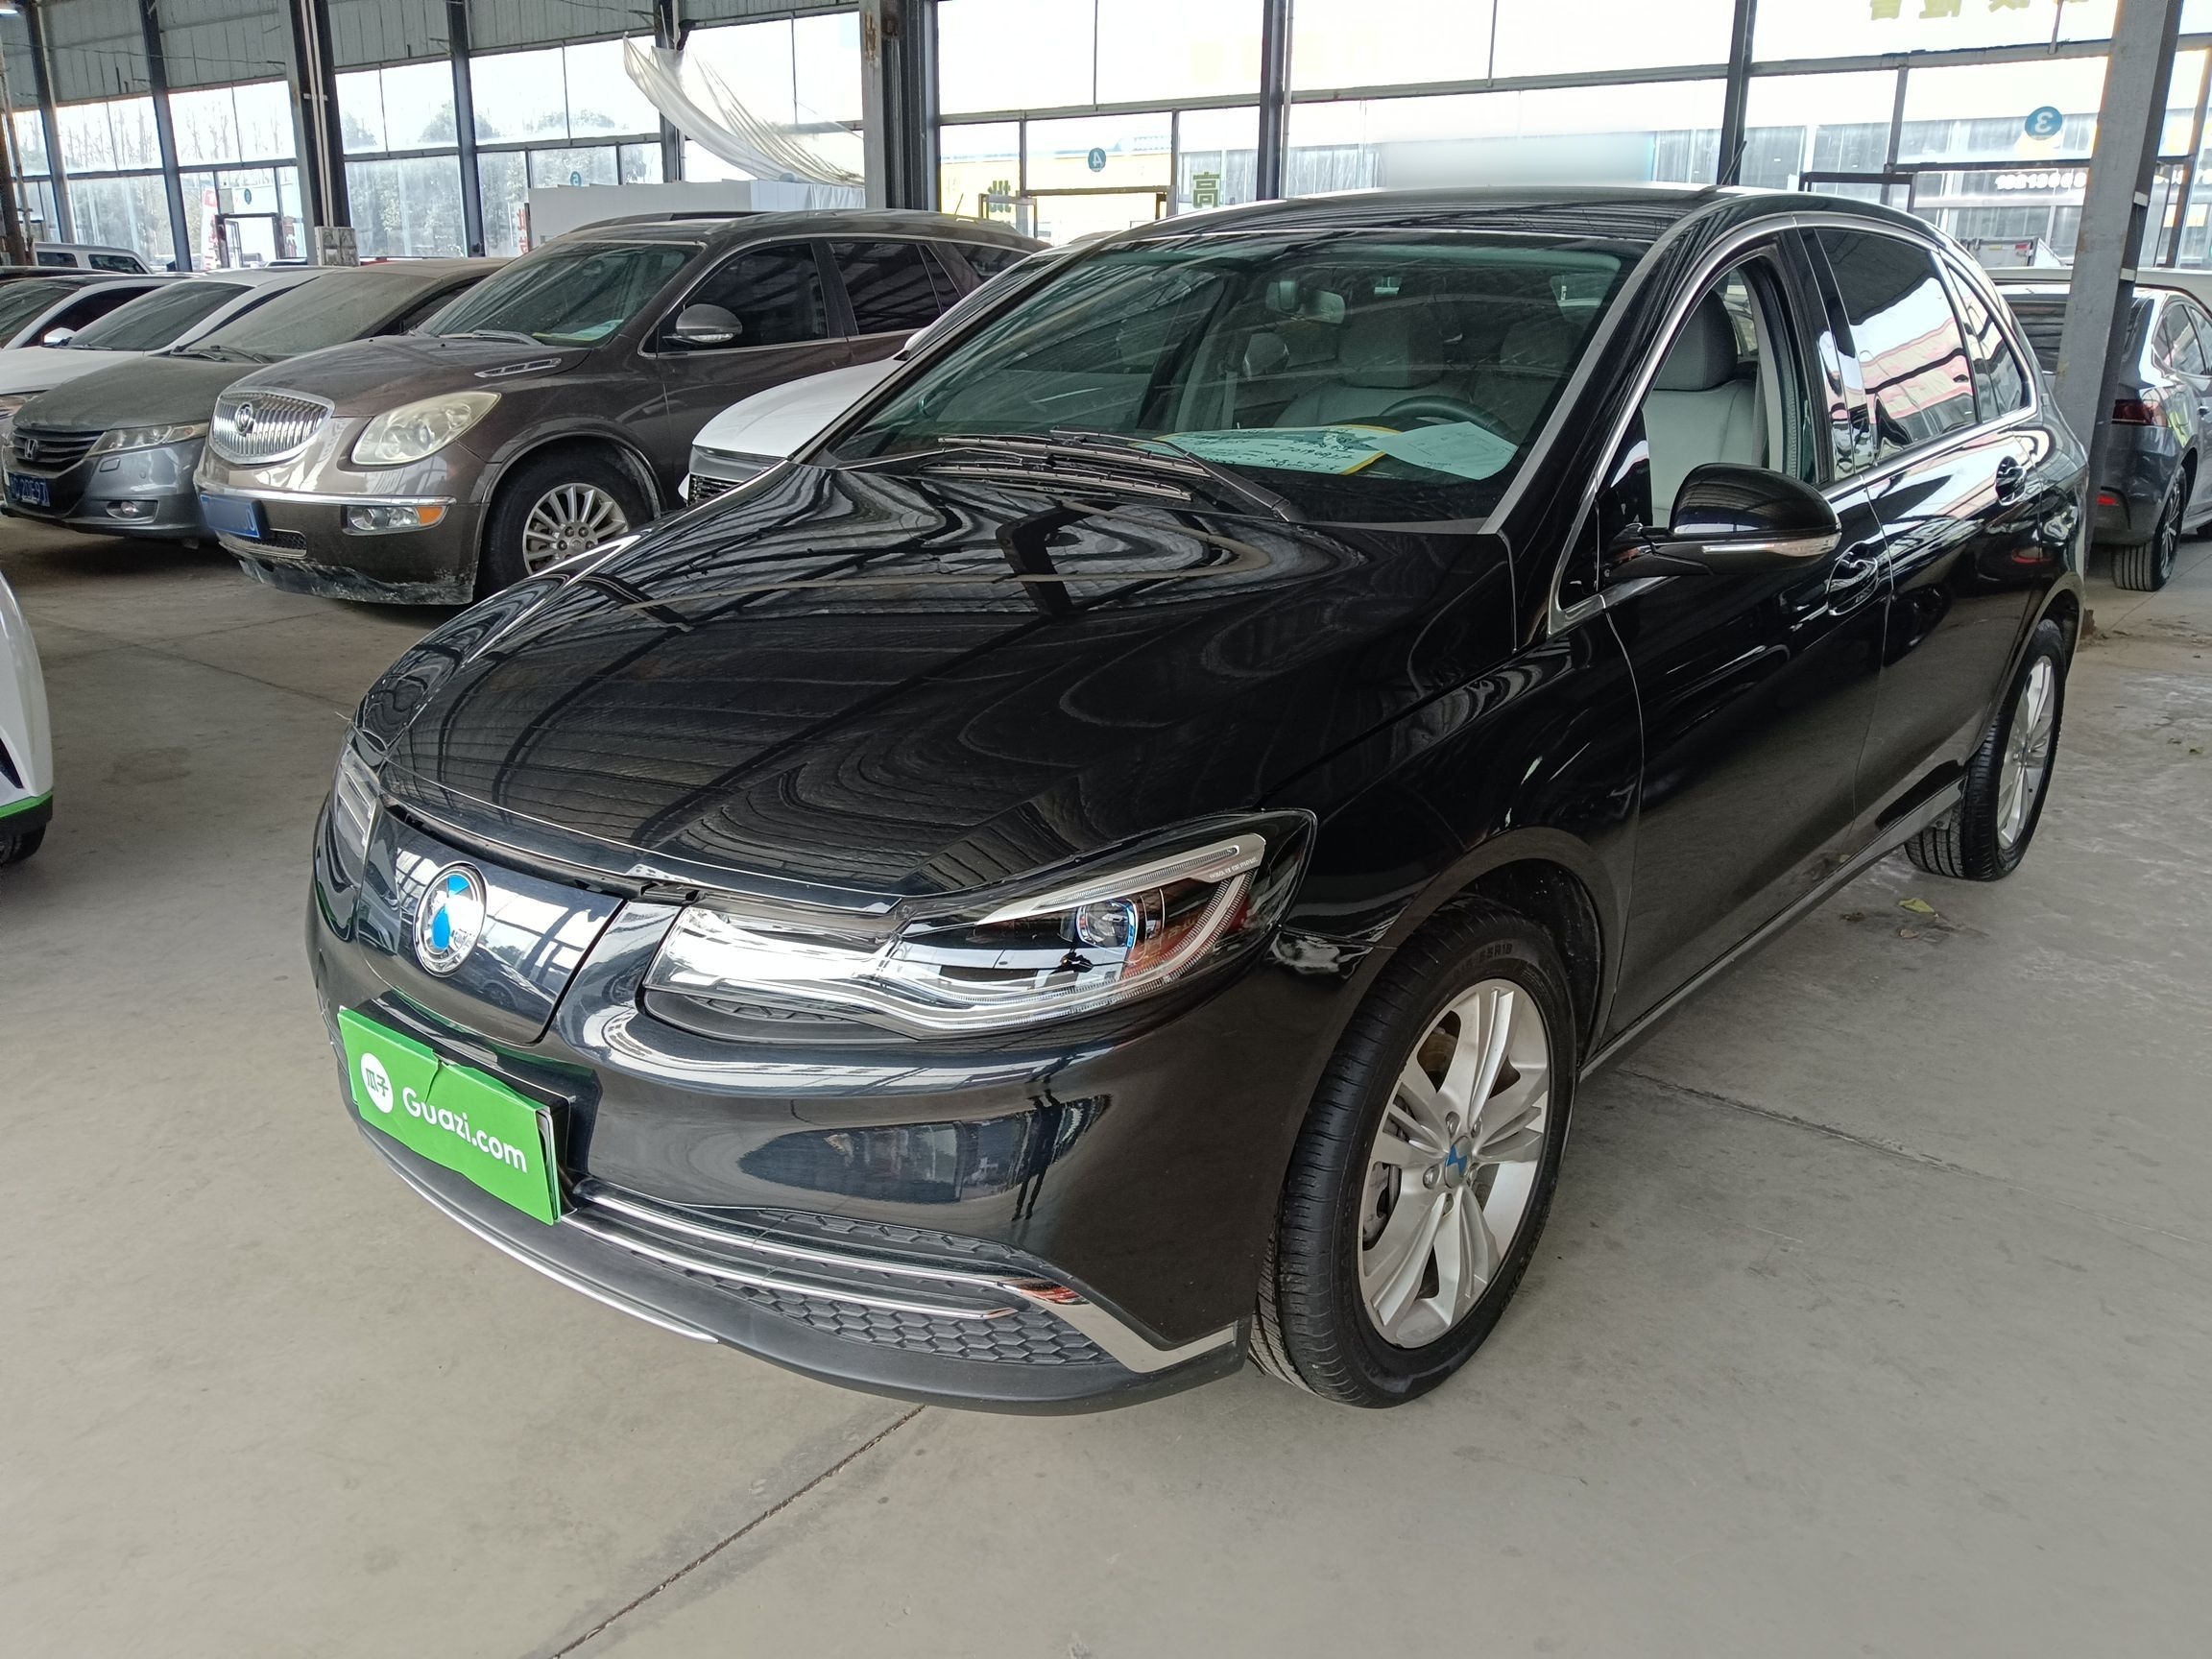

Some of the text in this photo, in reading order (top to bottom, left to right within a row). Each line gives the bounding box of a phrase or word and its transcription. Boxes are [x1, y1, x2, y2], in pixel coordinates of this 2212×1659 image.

[1192, 171, 1220, 209] 高
[365, 1067, 390, 1097] 瓜子
[401, 1086, 528, 1174] Guazi.com
